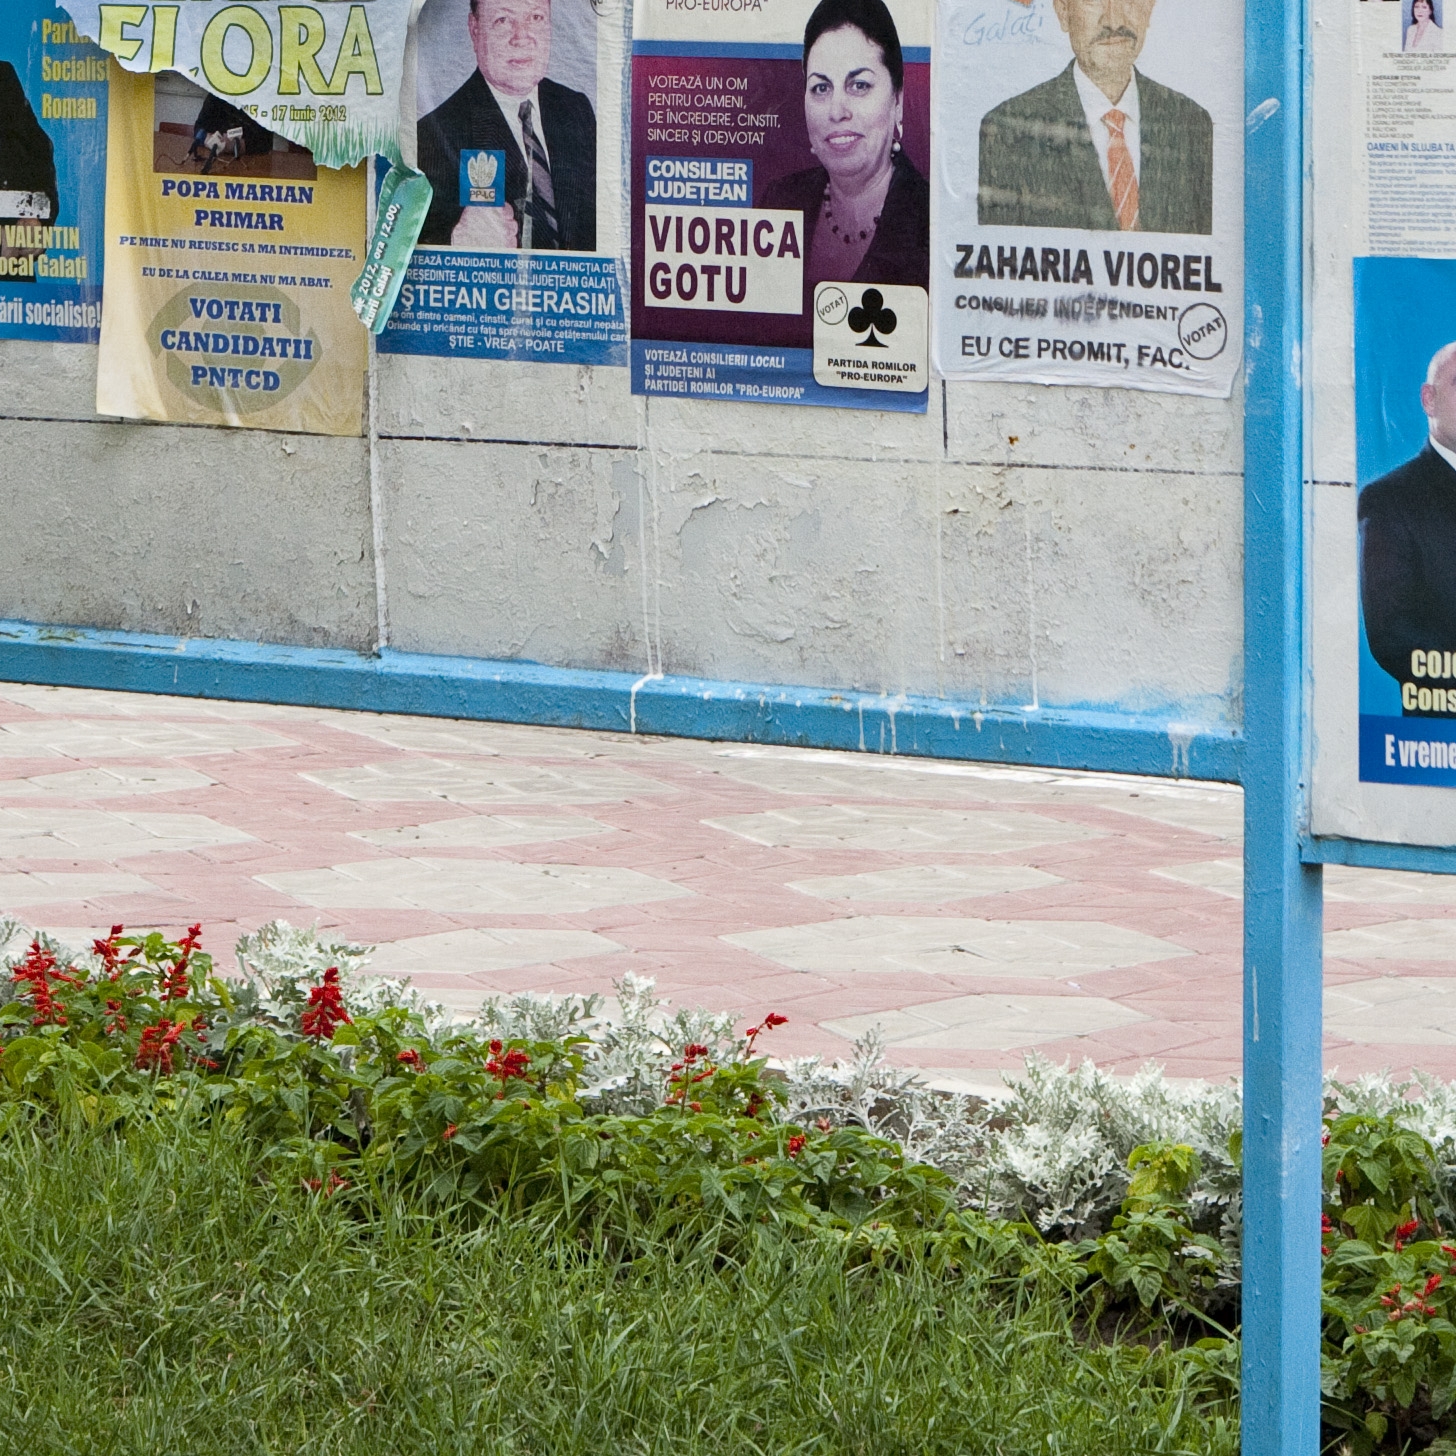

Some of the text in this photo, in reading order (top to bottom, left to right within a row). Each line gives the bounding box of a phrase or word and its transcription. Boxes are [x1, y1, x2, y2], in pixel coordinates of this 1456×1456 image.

[271, 105, 346, 122] 17 iunie 2012
[649, 161, 747, 180] CONSILIER
[161, 179, 313, 204] POPA MARIAN
[194, 209, 284, 231] PRIMAR
[374, 241, 385, 259] ora
[649, 215, 800, 258] VIORICA
[954, 244, 1223, 293] ZAHARIA VIOREL
[649, 262, 747, 303] GOTU
[190, 298, 281, 323] VOTATI
[402, 285, 615, 315] ȘTEFAN GHERASIM
[820, 296, 845, 317] VOTAT
[161, 330, 313, 360] CANDIDATII
[1183, 317, 1223, 346] VOTAT
[828, 358, 916, 372] PARTIDA ROMILOR
[962, 336, 1190, 370] EU CE PROMIT, FAC.
[1385, 735, 1394, 766] E
